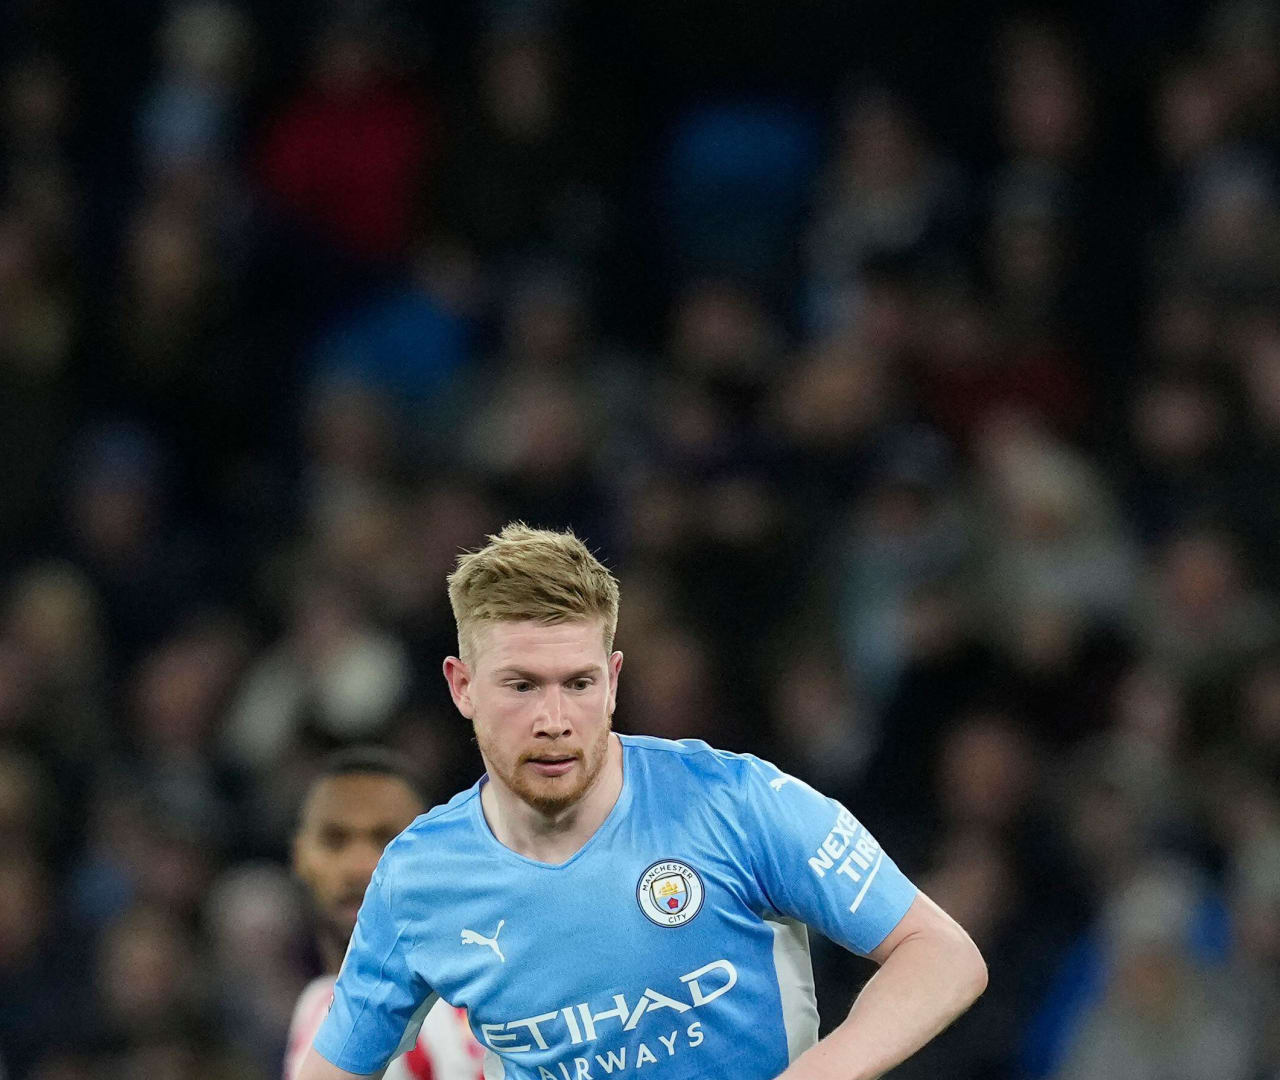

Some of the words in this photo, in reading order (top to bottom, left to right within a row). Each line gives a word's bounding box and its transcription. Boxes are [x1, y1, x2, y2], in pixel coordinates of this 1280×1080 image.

[642, 864, 694, 892] MANCHESTER
[668, 912, 688, 924] CITY
[481, 958, 738, 1054] ETIHAD
